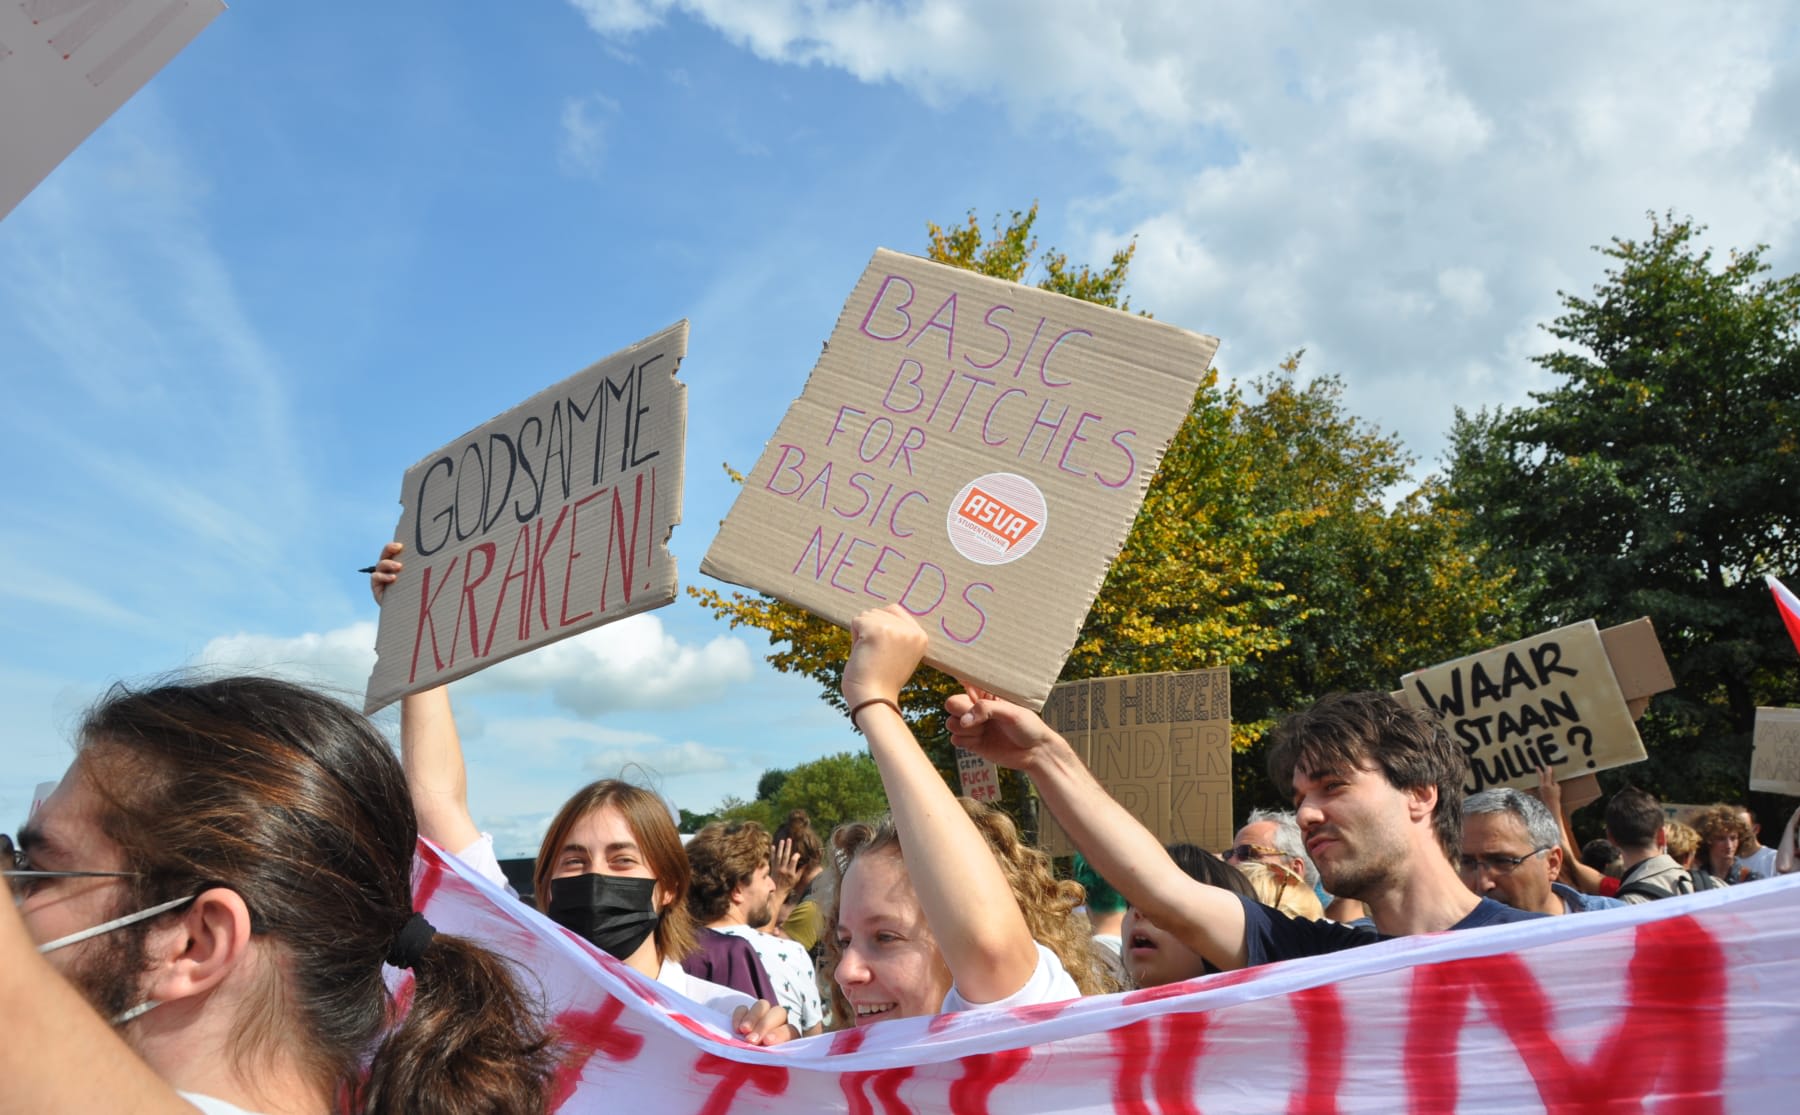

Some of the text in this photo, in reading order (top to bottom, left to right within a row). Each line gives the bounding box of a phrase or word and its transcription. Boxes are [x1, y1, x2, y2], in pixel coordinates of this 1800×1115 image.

[859, 275, 1093, 388] BASIC
[415, 353, 664, 557] GODSAMME
[826, 405, 926, 476] FOR
[882, 358, 1137, 489] BITCHES
[766, 444, 930, 539] BASIC
[964, 495, 1027, 540] ASVA
[408, 467, 656, 684] KRAKEN!
[793, 525, 994, 645] NEEDS
[1119, 671, 1231, 727] HUIZEN
[1415, 642, 1579, 719] WAAR
[1070, 725, 1231, 780] INDER
[1453, 690, 1581, 755] STAAN
[961, 768, 990, 788] FUCK
